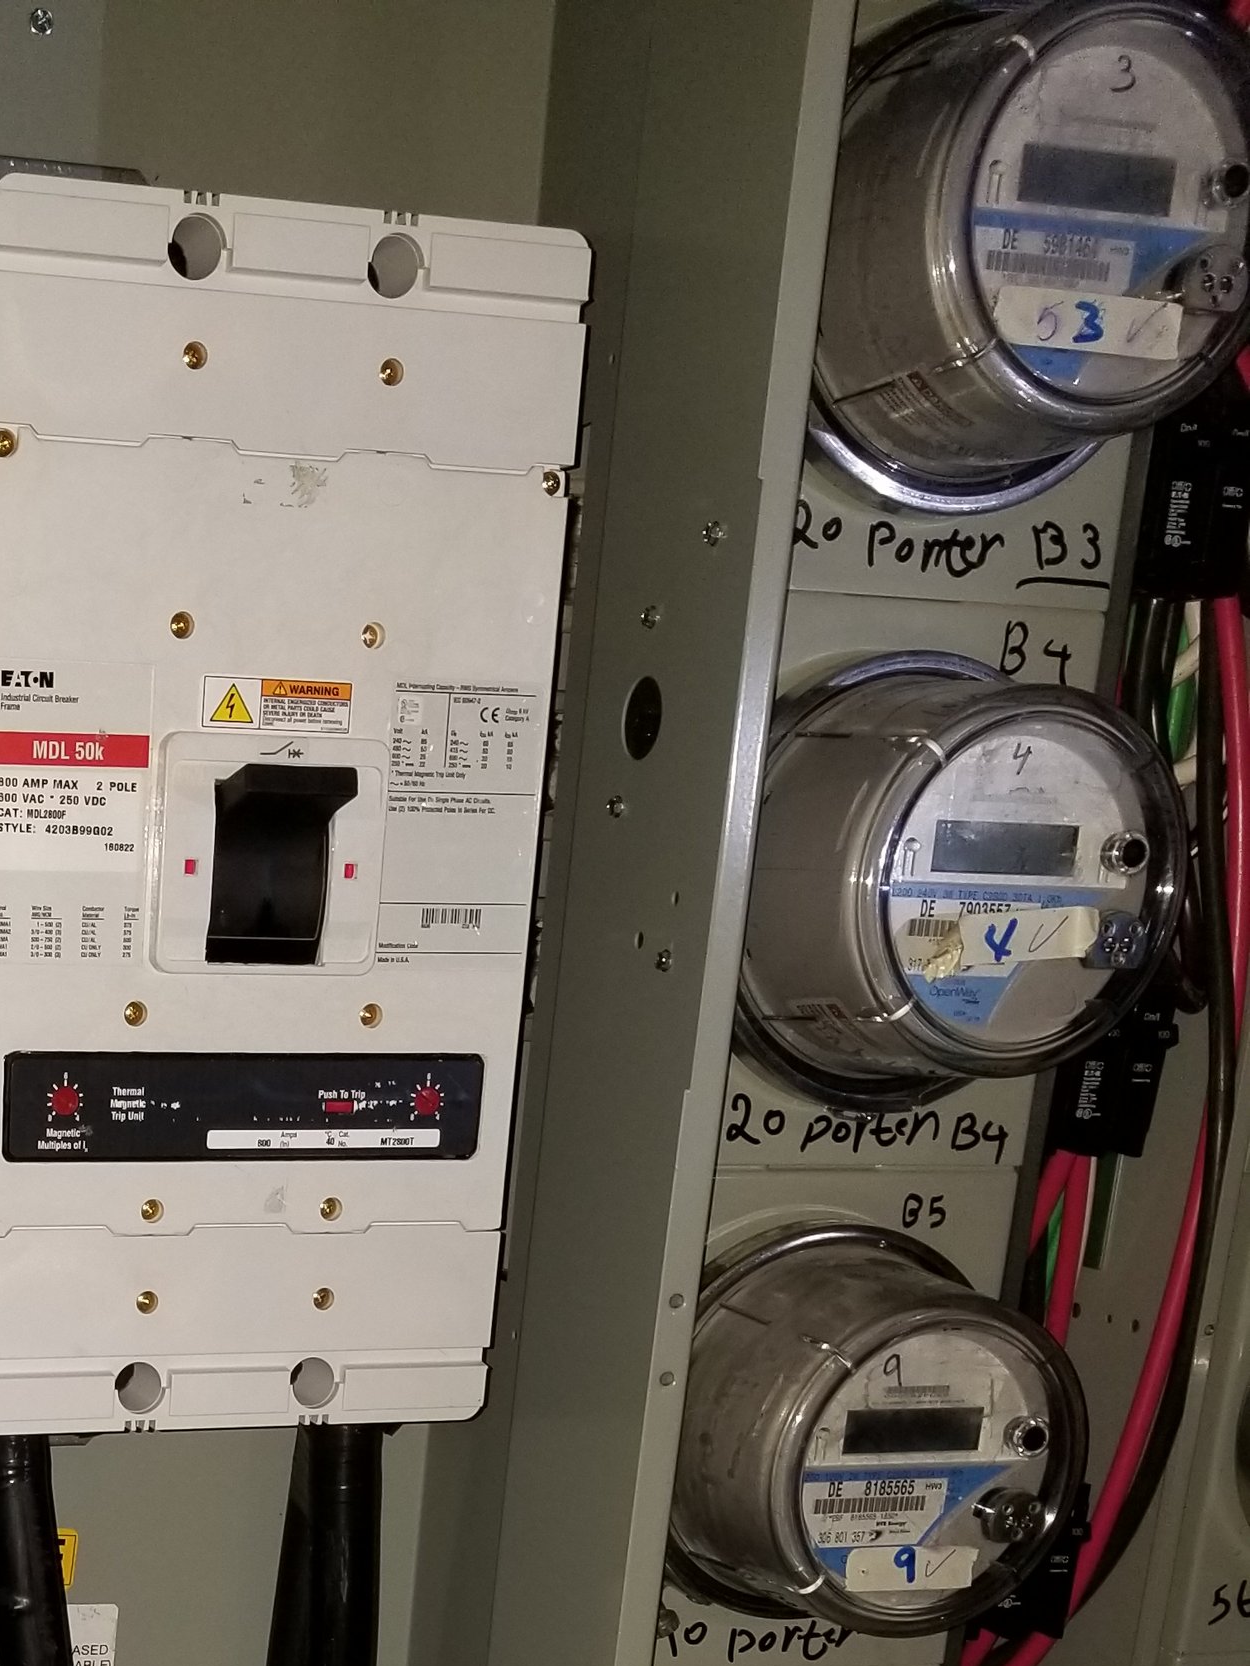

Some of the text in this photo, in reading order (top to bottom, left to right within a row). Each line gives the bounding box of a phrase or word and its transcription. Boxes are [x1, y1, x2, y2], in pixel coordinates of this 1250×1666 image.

[1109, 54, 1137, 93] 3
[1002, 228, 1018, 250] DE
[1071, 300, 1105, 344] 3
[1032, 519, 1102, 571] B3
[999, 620, 1072, 687] B4
[0, 669, 55, 689] EATON
[0, 693, 80, 704] Industrial Circuit Breaker
[289, 684, 340, 697] WARNING
[0, 702, 21, 711] Frame
[479, 706, 501, 724] CE
[32, 740, 105, 761] MDL 50k
[1012, 742, 1033, 775] 4
[22, 778, 49, 789] AMP
[52, 779, 79, 790] MAX
[96, 781, 103, 791] 2
[109, 781, 137, 793] POLE
[22, 793, 45, 804] VAC
[59, 795, 79, 806] 250
[84, 796, 107, 806] VDC
[26, 808, 67, 820] MDL2800F
[45, 824, 114, 837] 4203B99G02
[920, 900, 936, 917] DE
[983, 917, 1018, 962] 4
[112, 1086, 145, 1097] Thermal
[318, 1089, 366, 1101] Push To Trip
[110, 1098, 147, 1110] Magnetic
[111, 1111, 144, 1122] Trip Unit
[46, 1128, 81, 1139] Magnetic
[280, 1130, 297, 1139] Amps
[725, 1092, 786, 1145] 20
[950, 1111, 1009, 1164] B4
[37, 1140, 72, 1152] Multiples
[73, 1140, 81, 1150] of
[326, 1137, 335, 1146] 40
[902, 1193, 947, 1229] B5
[883, 1353, 903, 1387] 9
[828, 1481, 844, 1498] DE
[864, 1479, 916, 1497] 8185565
[893, 1546, 916, 1584] 9
[71, 1644, 109, 1657] ASED
